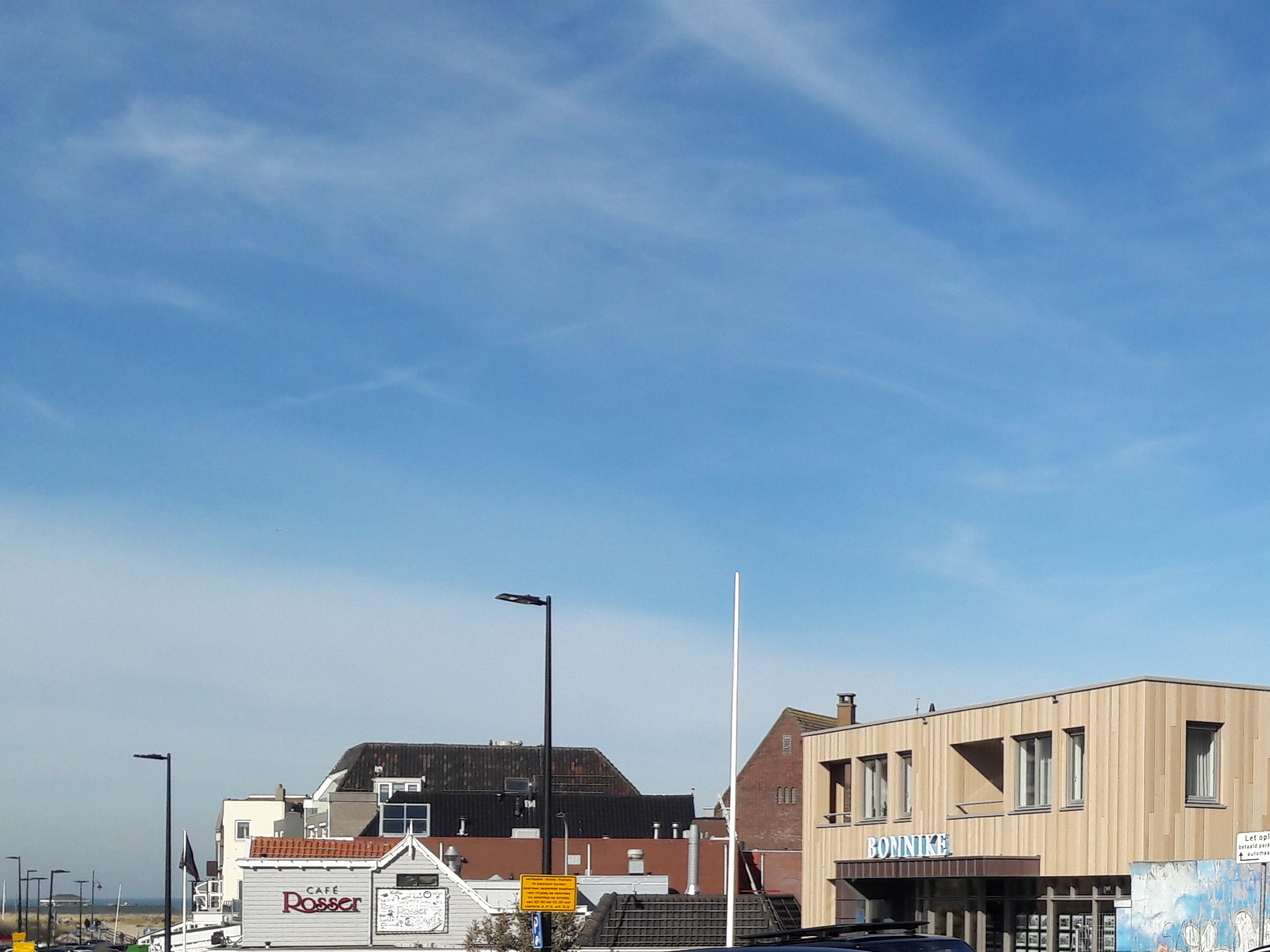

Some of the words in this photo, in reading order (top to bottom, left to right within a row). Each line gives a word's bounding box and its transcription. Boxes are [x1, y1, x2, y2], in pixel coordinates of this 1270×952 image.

[867, 833, 951, 859] BONNIKE
[1244, 834, 1257, 842] Let
[306, 886, 339, 895] CAFÉ
[282, 891, 362, 914] Rosser
